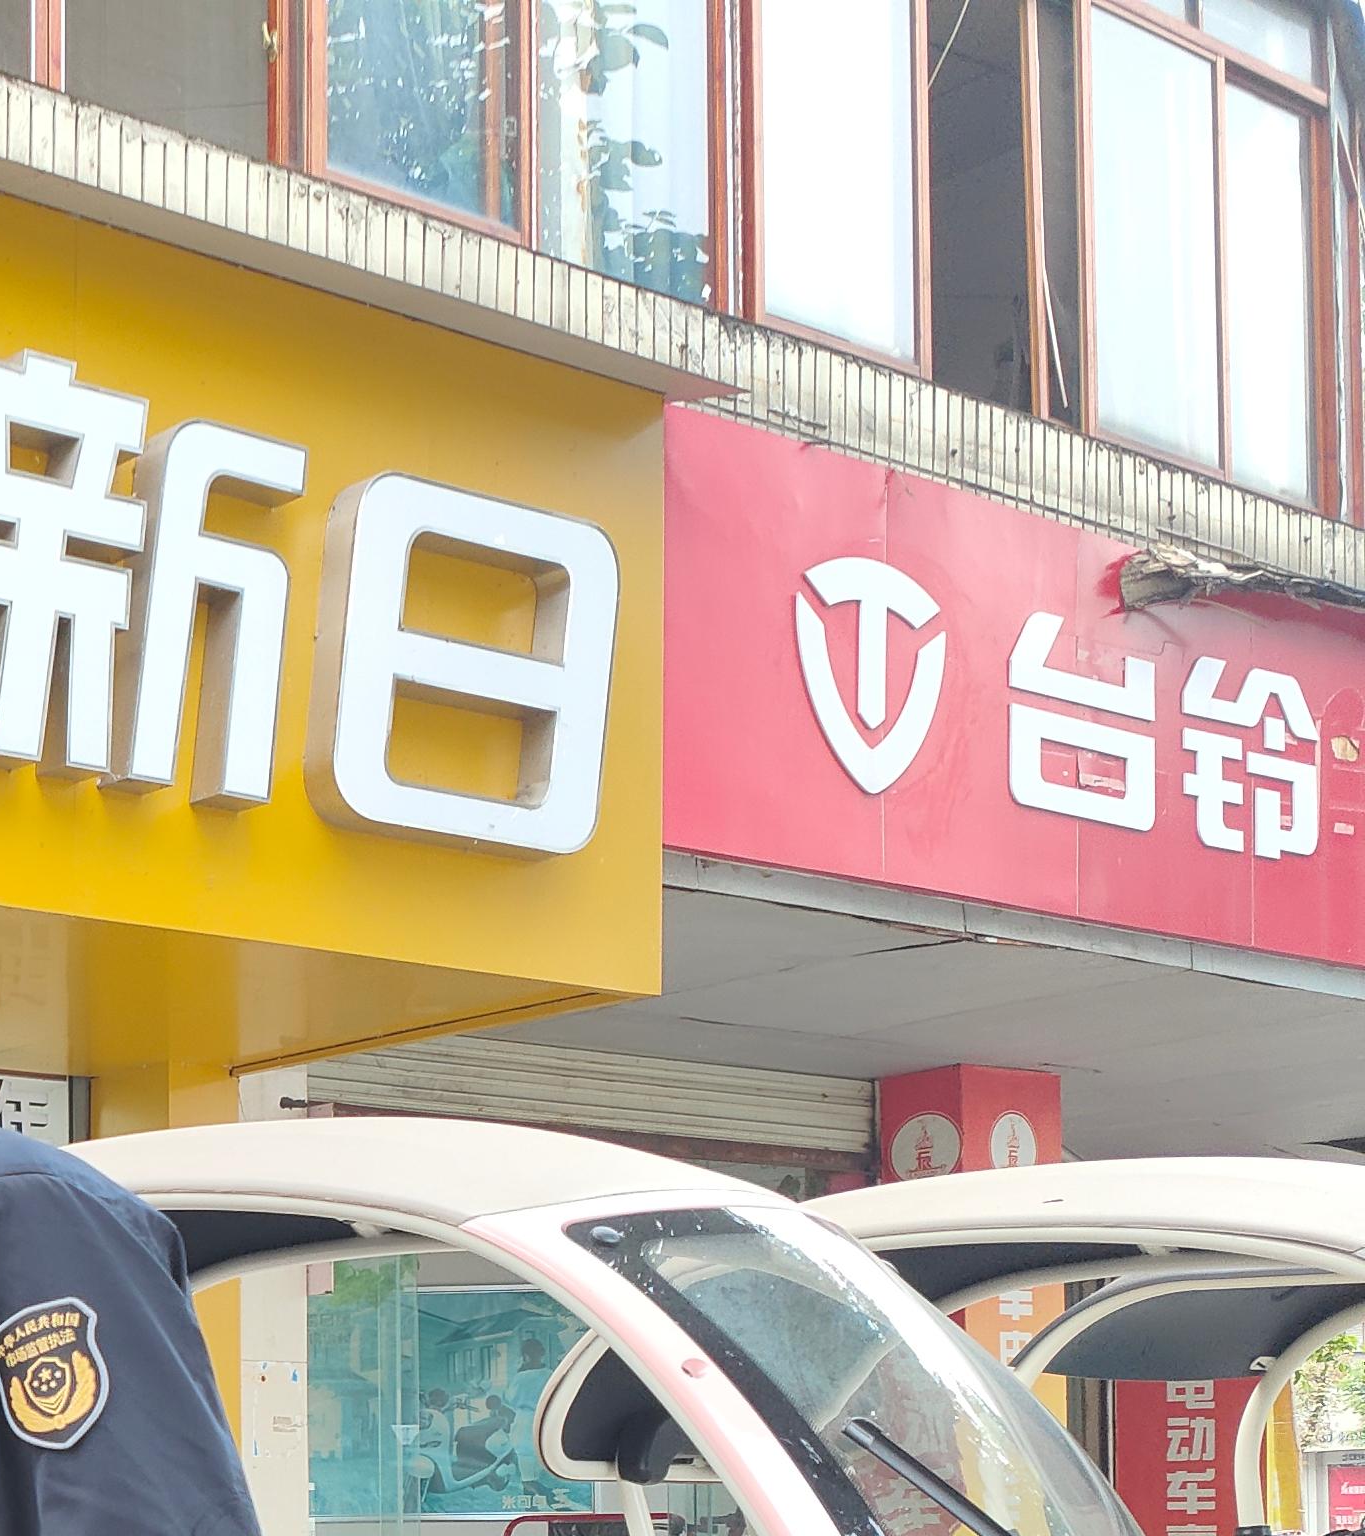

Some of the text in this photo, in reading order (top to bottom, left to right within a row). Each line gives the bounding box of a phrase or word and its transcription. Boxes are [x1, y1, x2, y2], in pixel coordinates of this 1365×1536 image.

[1008, 610, 1321, 860] 台铃
[4, 1328, 77, 1368] 市场监管执法
